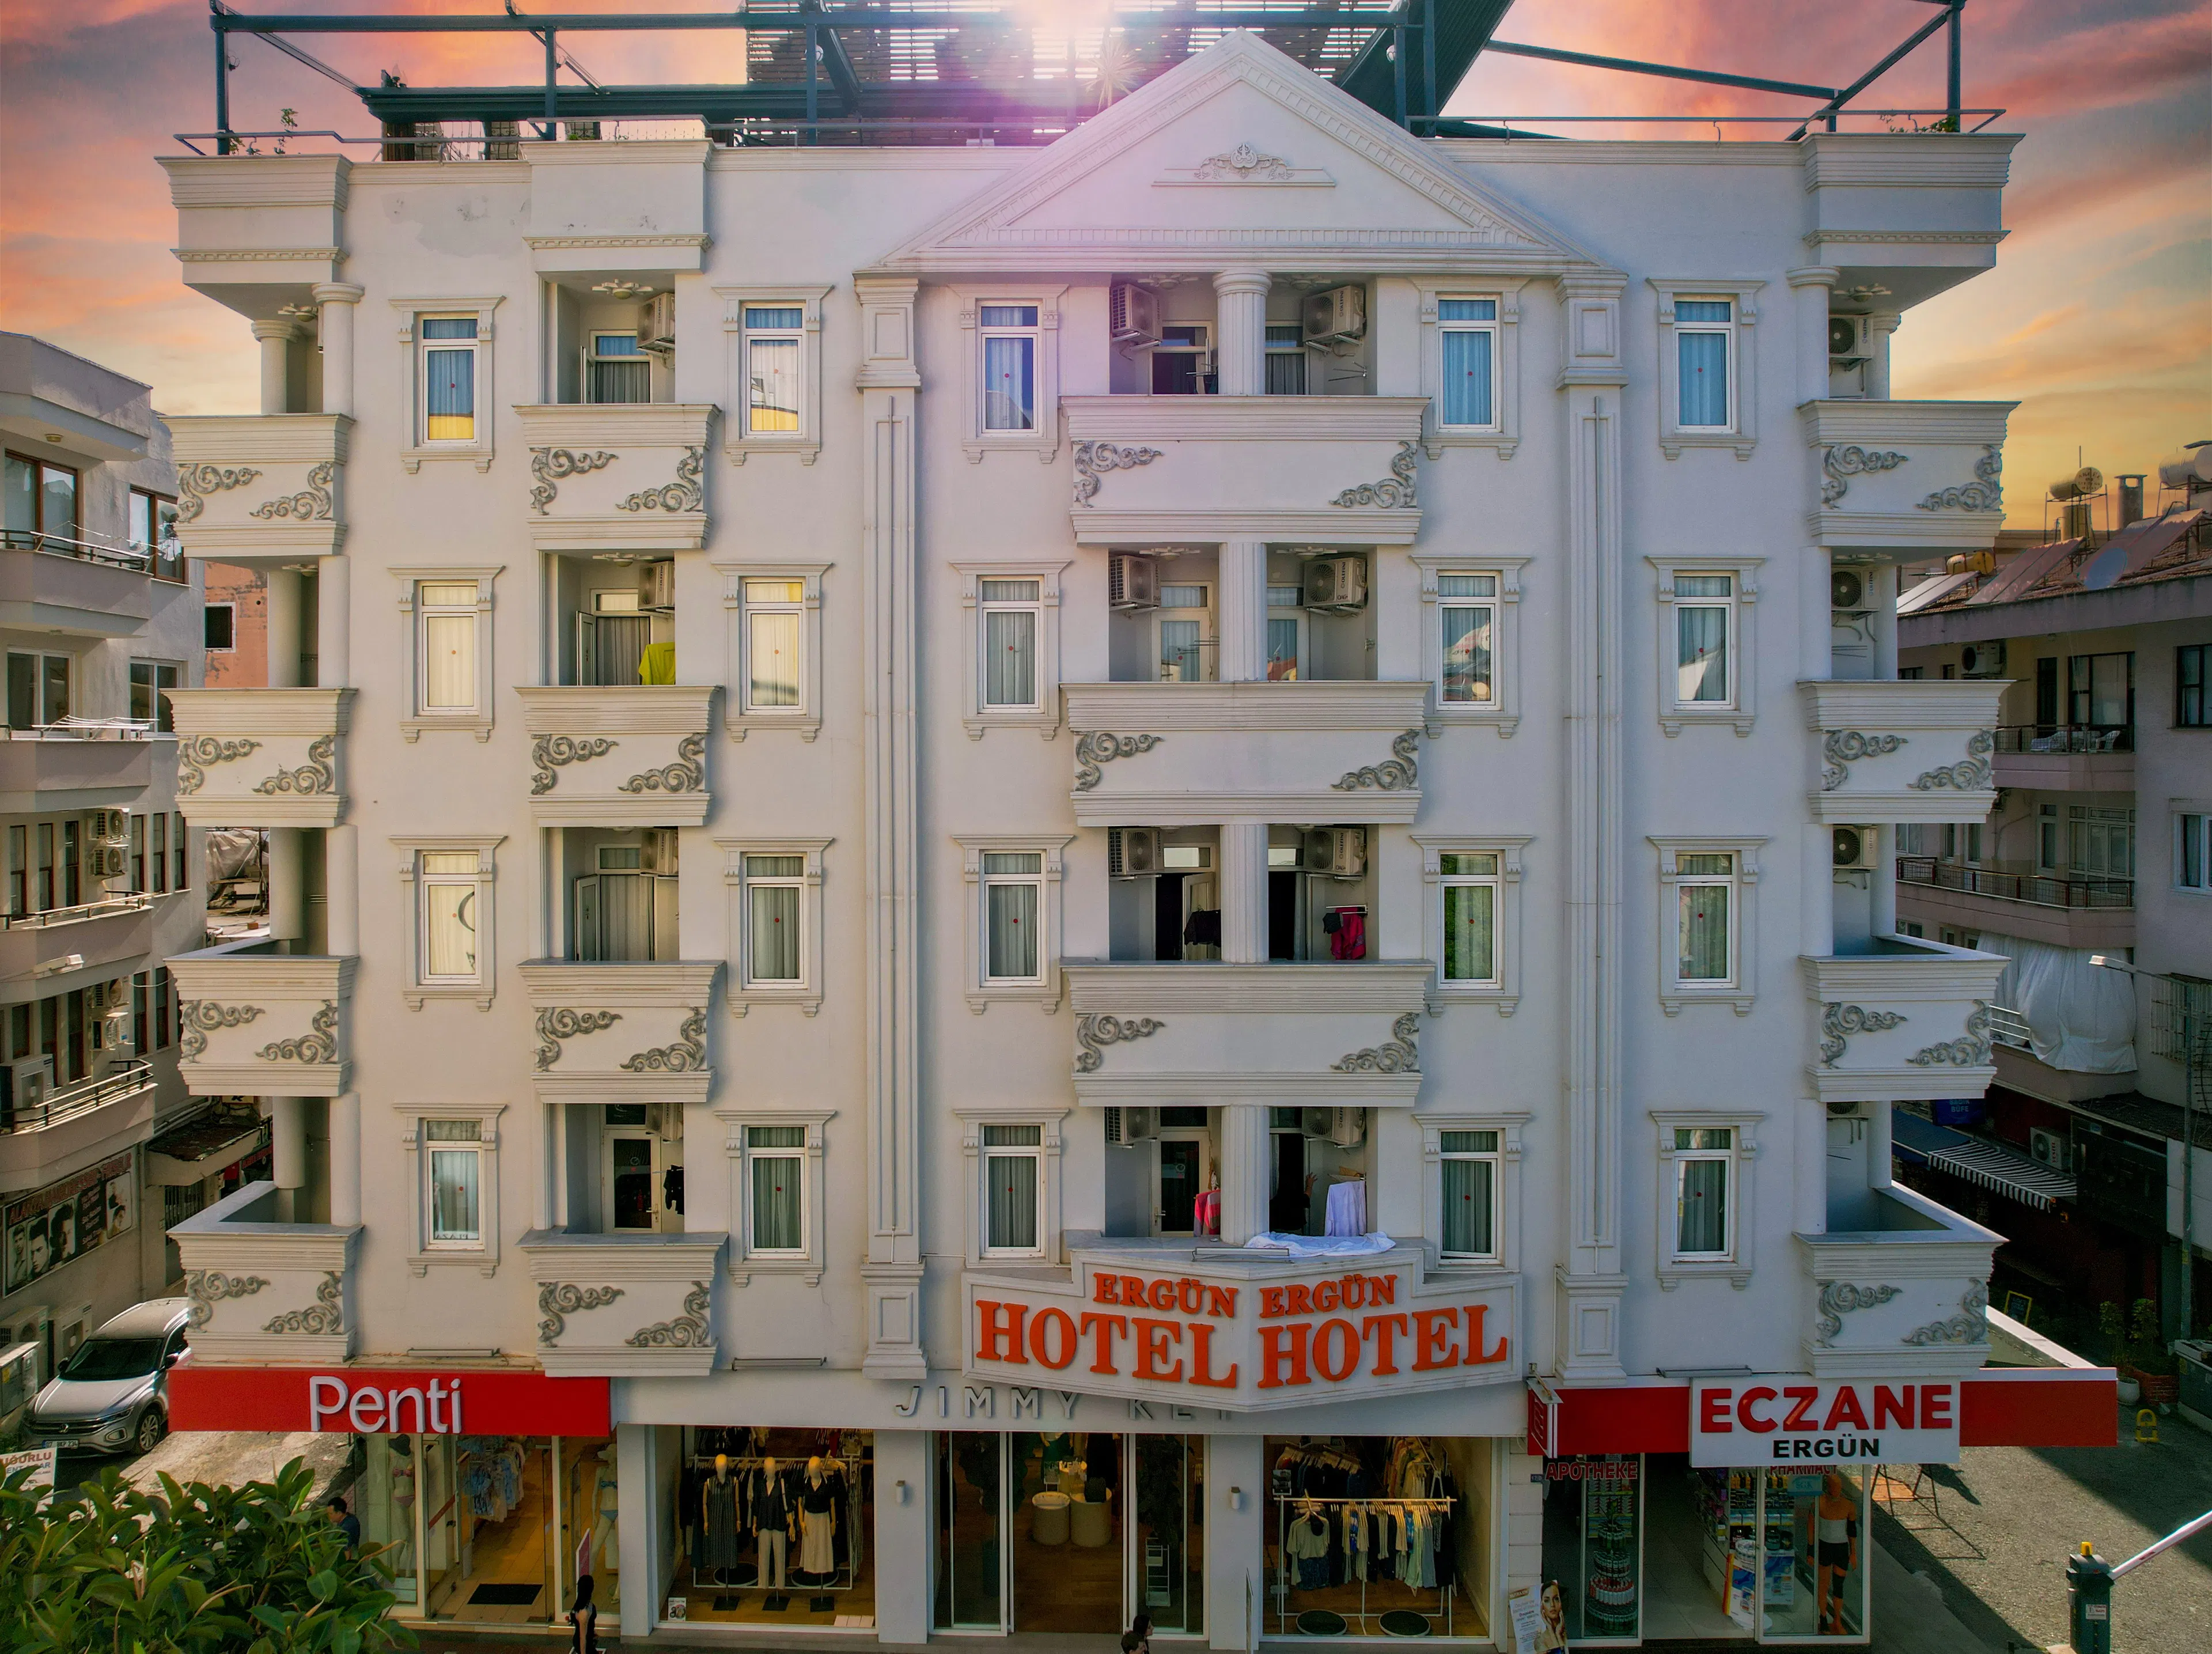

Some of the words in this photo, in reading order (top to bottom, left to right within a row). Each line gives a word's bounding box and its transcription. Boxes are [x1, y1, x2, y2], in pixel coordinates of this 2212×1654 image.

[1093, 1272, 1238, 1318] ERGÜN
[1259, 1274, 1397, 1318] ERGÜN
[976, 1299, 1237, 1388] HOTEL
[1257, 1304, 1508, 1388] HOTEL
[309, 1376, 461, 1433] Penti
[895, 1386, 1080, 1419] JIMMY
[1700, 1384, 1952, 1433] ECZANE
[1773, 1433, 1879, 1458] ERGÜN
[1545, 1462, 1638, 1481] APOTHEKE
